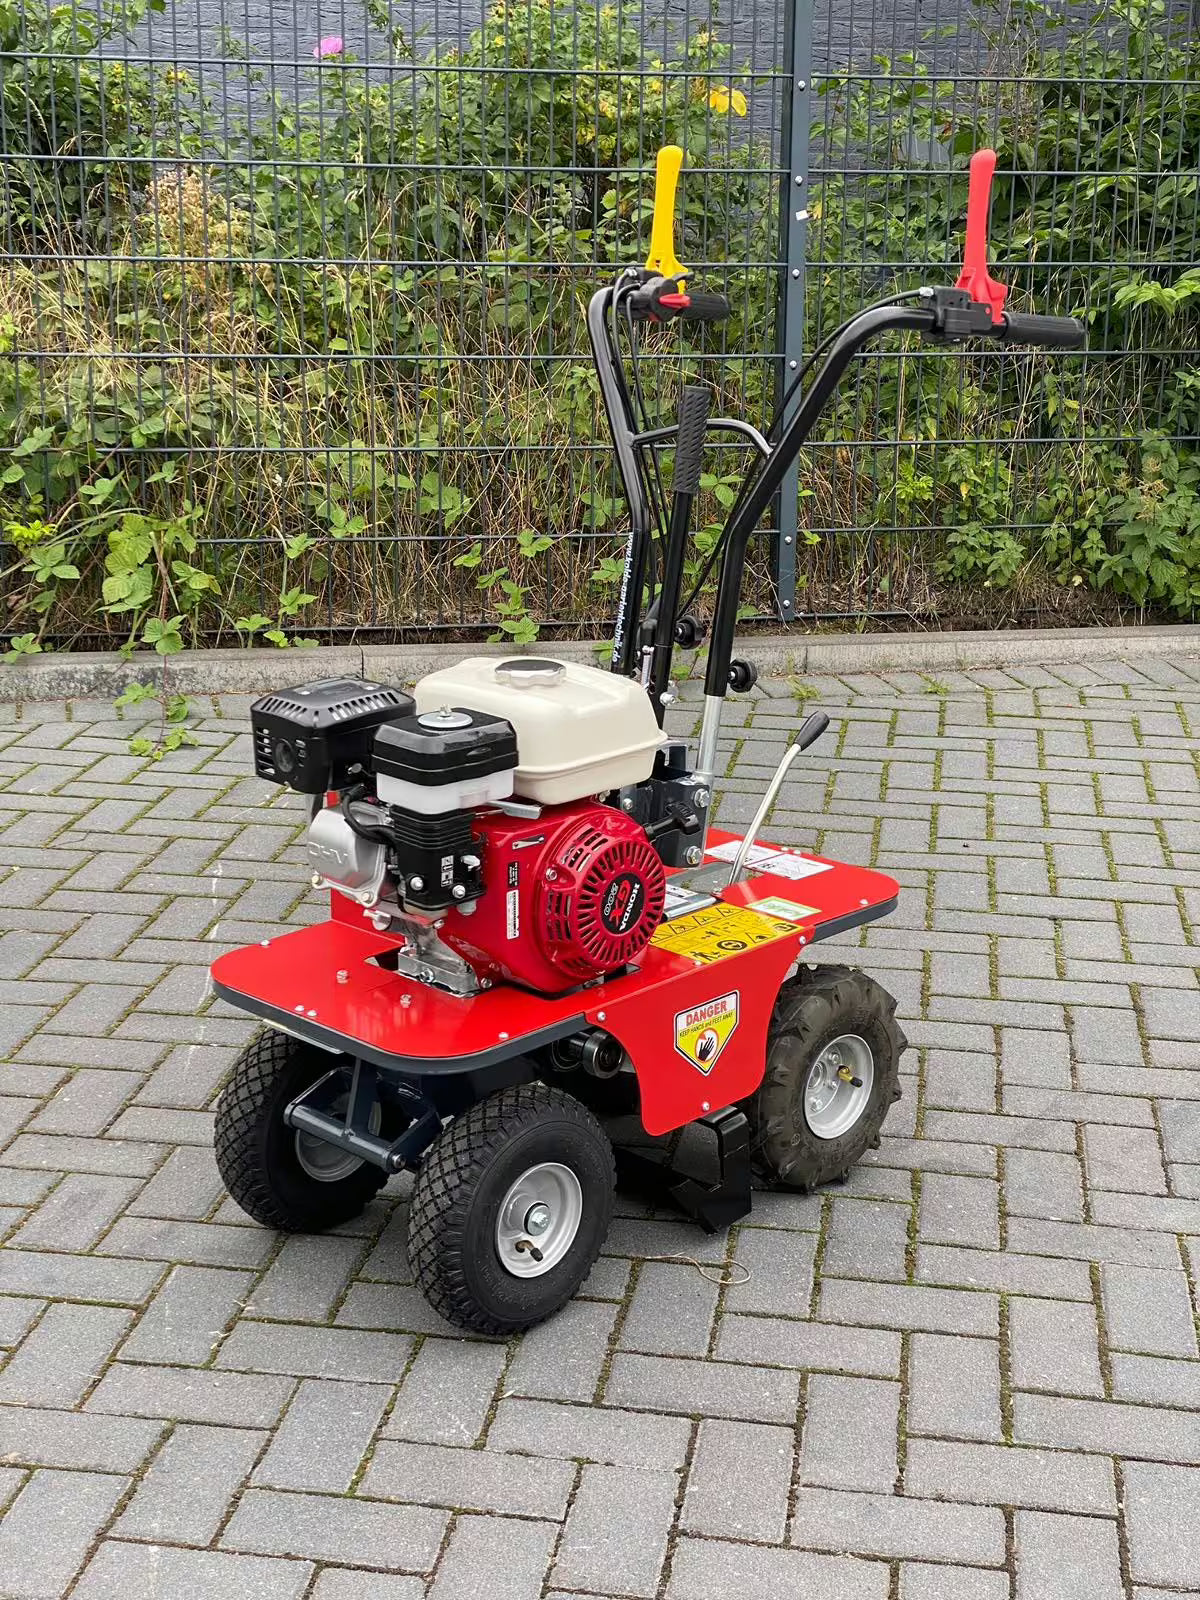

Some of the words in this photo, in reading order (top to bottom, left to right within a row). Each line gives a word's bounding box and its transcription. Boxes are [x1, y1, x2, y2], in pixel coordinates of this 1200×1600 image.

[609, 880, 631, 927] GX
[619, 883, 640, 931] HONDA
[679, 1028, 691, 1037] KEEP
[712, 1015, 722, 1025] FEET
[685, 1000, 728, 1026] DANGER
